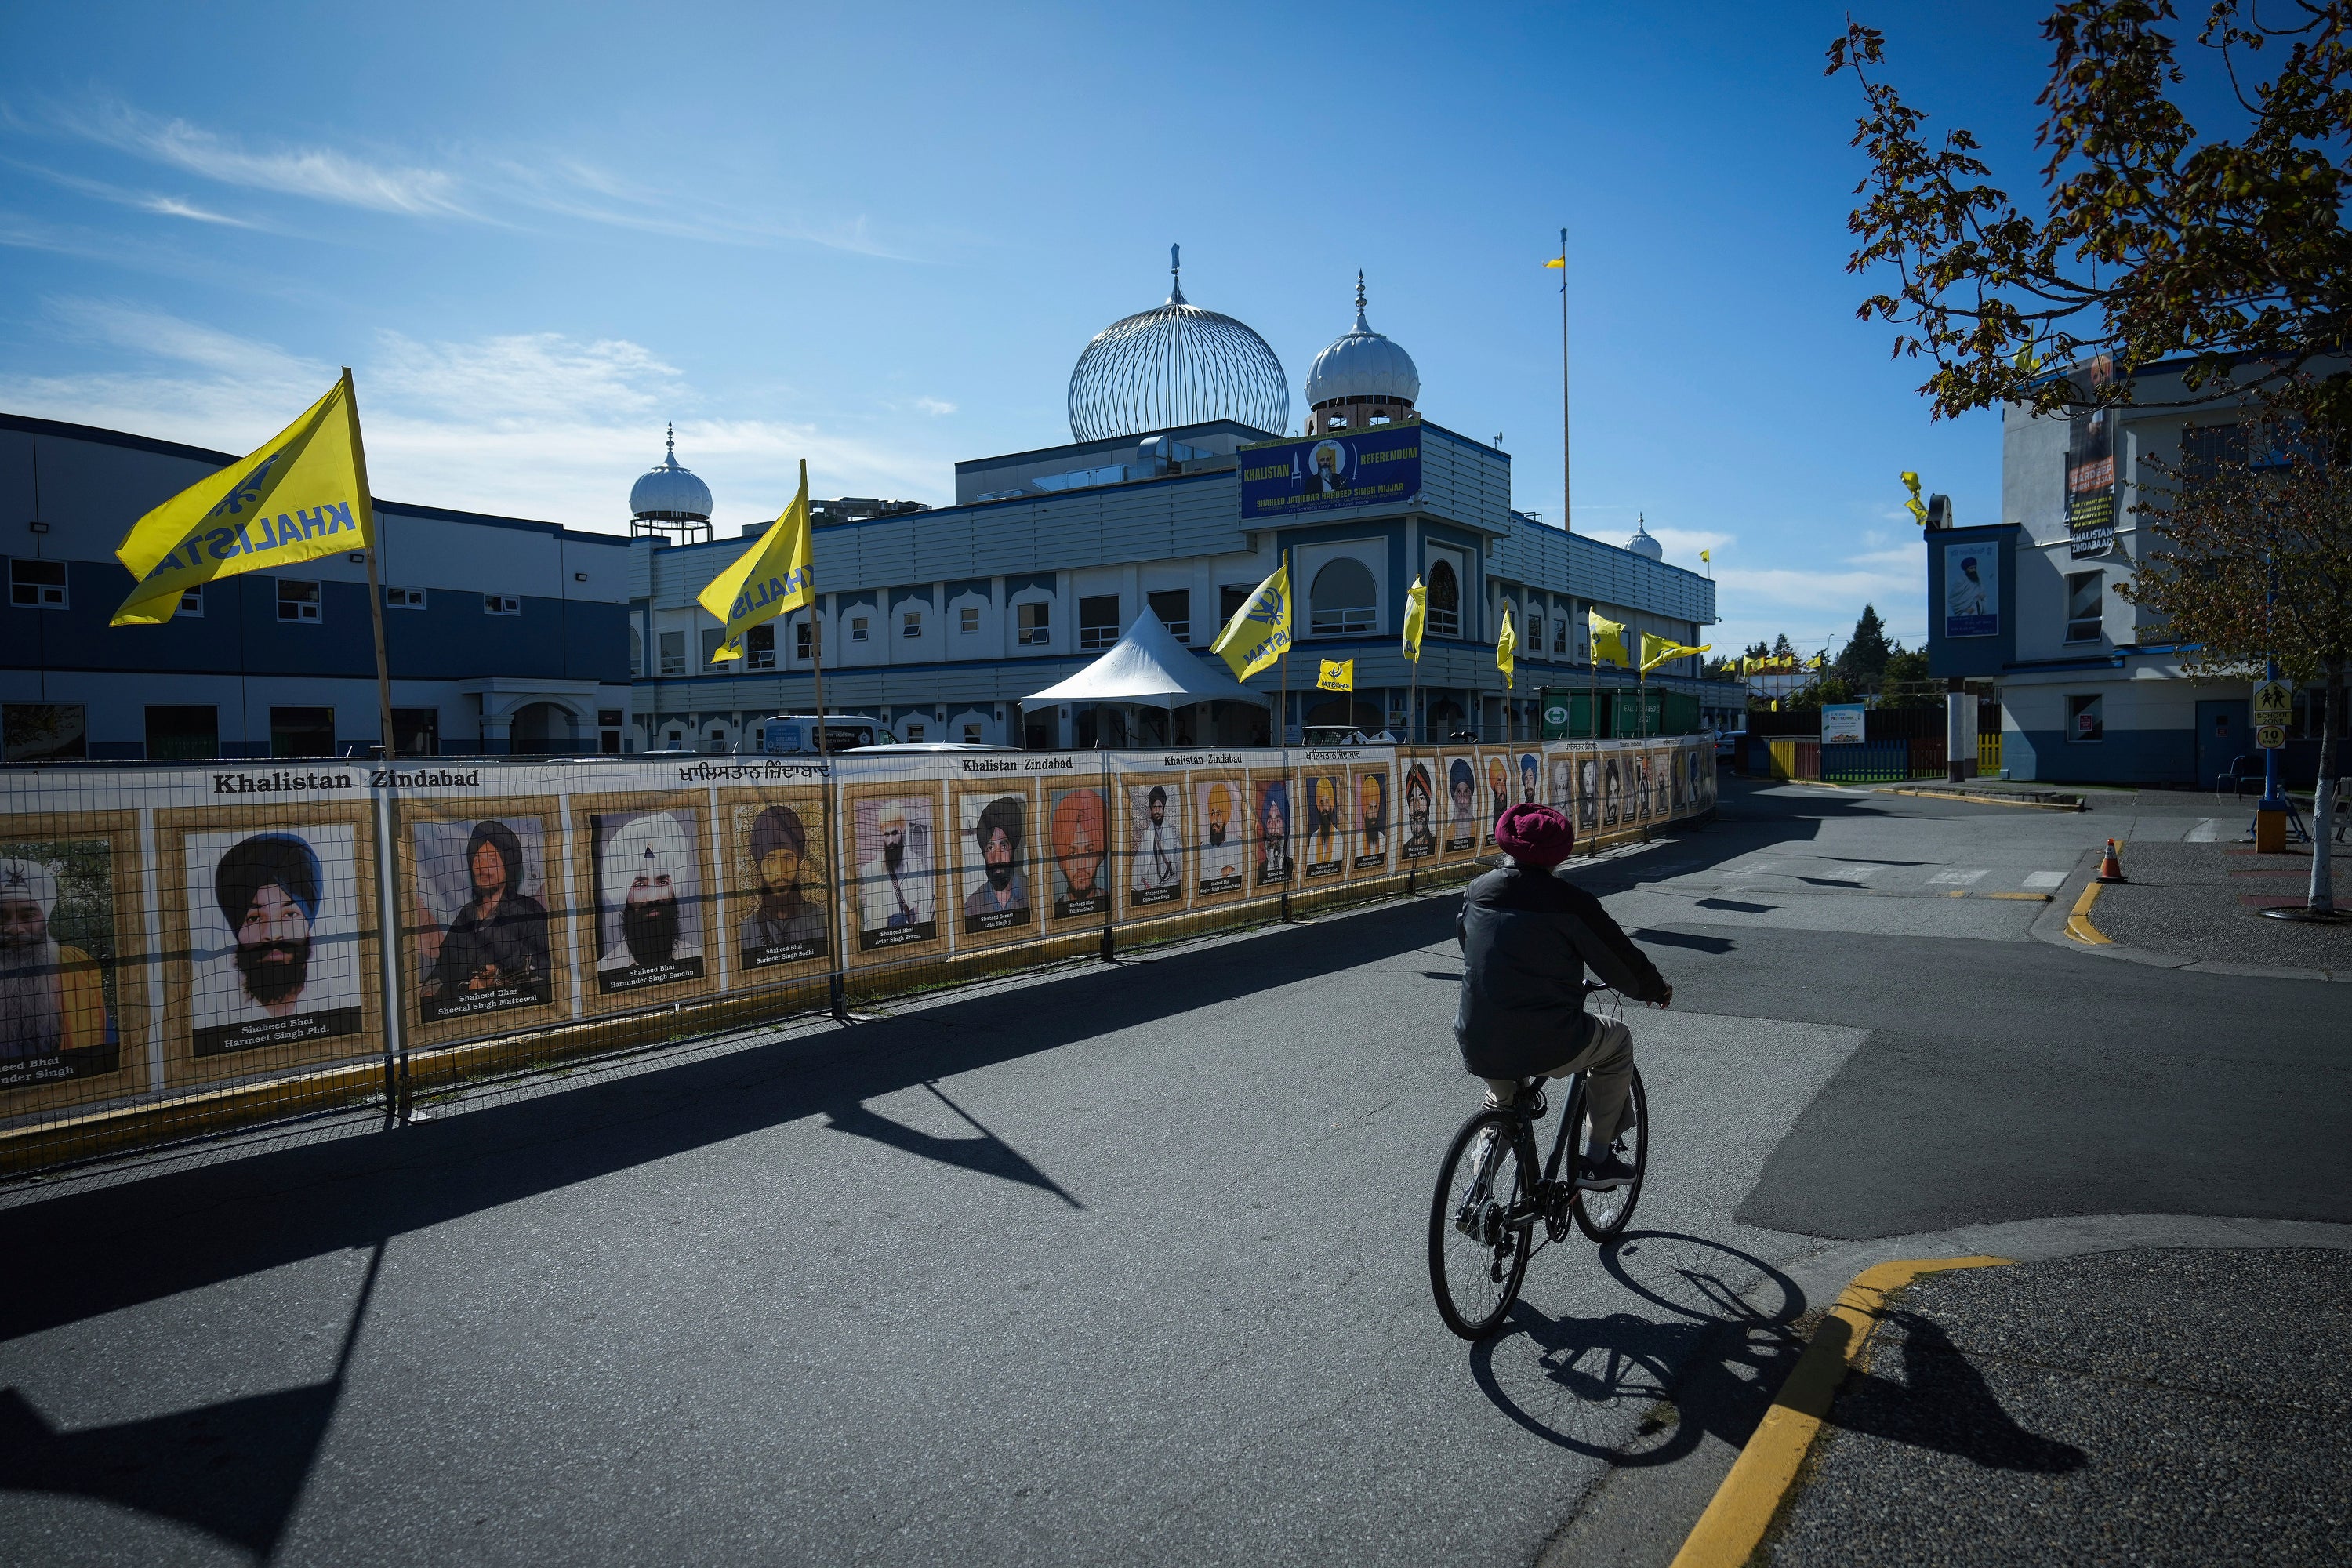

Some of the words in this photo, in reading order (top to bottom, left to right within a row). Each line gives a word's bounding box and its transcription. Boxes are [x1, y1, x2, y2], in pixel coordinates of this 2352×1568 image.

[1360, 447, 1417, 465] REFERENDUM
[1243, 464, 1289, 481] KHALISTAN
[2071, 464, 2111, 484] HARDEEP
[1257, 497, 1285, 508] SHAHEED
[1287, 493, 1320, 504] JATHEDAR
[1322, 489, 1352, 500] HARDEEP
[1354, 486, 1376, 496] SINGH
[1377, 482, 1404, 493] NIJJAR
[2071, 527, 2114, 543] KHALISTAN
[2072, 538, 2113, 553] ZINDABAAD
[963, 758, 1018, 771] Khalistan
[1024, 757, 1073, 770] Zindabad
[1164, 754, 1204, 767] Khalistan
[1207, 753, 1243, 765] Zindabad
[213, 771, 352, 793] Khalistan
[370, 769, 480, 789] Zindabad
[875, 937, 891, 946] Avtar
[891, 935, 905, 944] Singh
[880, 928, 902, 937] Shaheed
[756, 955, 780, 964] Surinder
[782, 953, 797, 962] Singh
[765, 946, 789, 955] Shaheed
[629, 967, 659, 977] Shaheed
[659, 964, 675, 972] Bhai
[610, 977, 648, 989] Harminder
[648, 974, 668, 985] Singh
[669, 969, 694, 979] Sandhu
[459, 990, 495, 1003] Shaheed
[498, 988, 517, 997] Bhai
[437, 1004, 471, 1016] Sheetal
[473, 1000, 497, 1012] Singh
[499, 994, 538, 1007] Mattewal
[241, 1021, 287, 1036] Shaheed
[290, 1017, 314, 1029] Bhai
[224, 1034, 272, 1048] Harmeet
[274, 1029, 306, 1044] Singh
[307, 1025, 330, 1038] Phd.
[29, 1056, 60, 1069] Bhai
[36, 1065, 74, 1081] Singh
